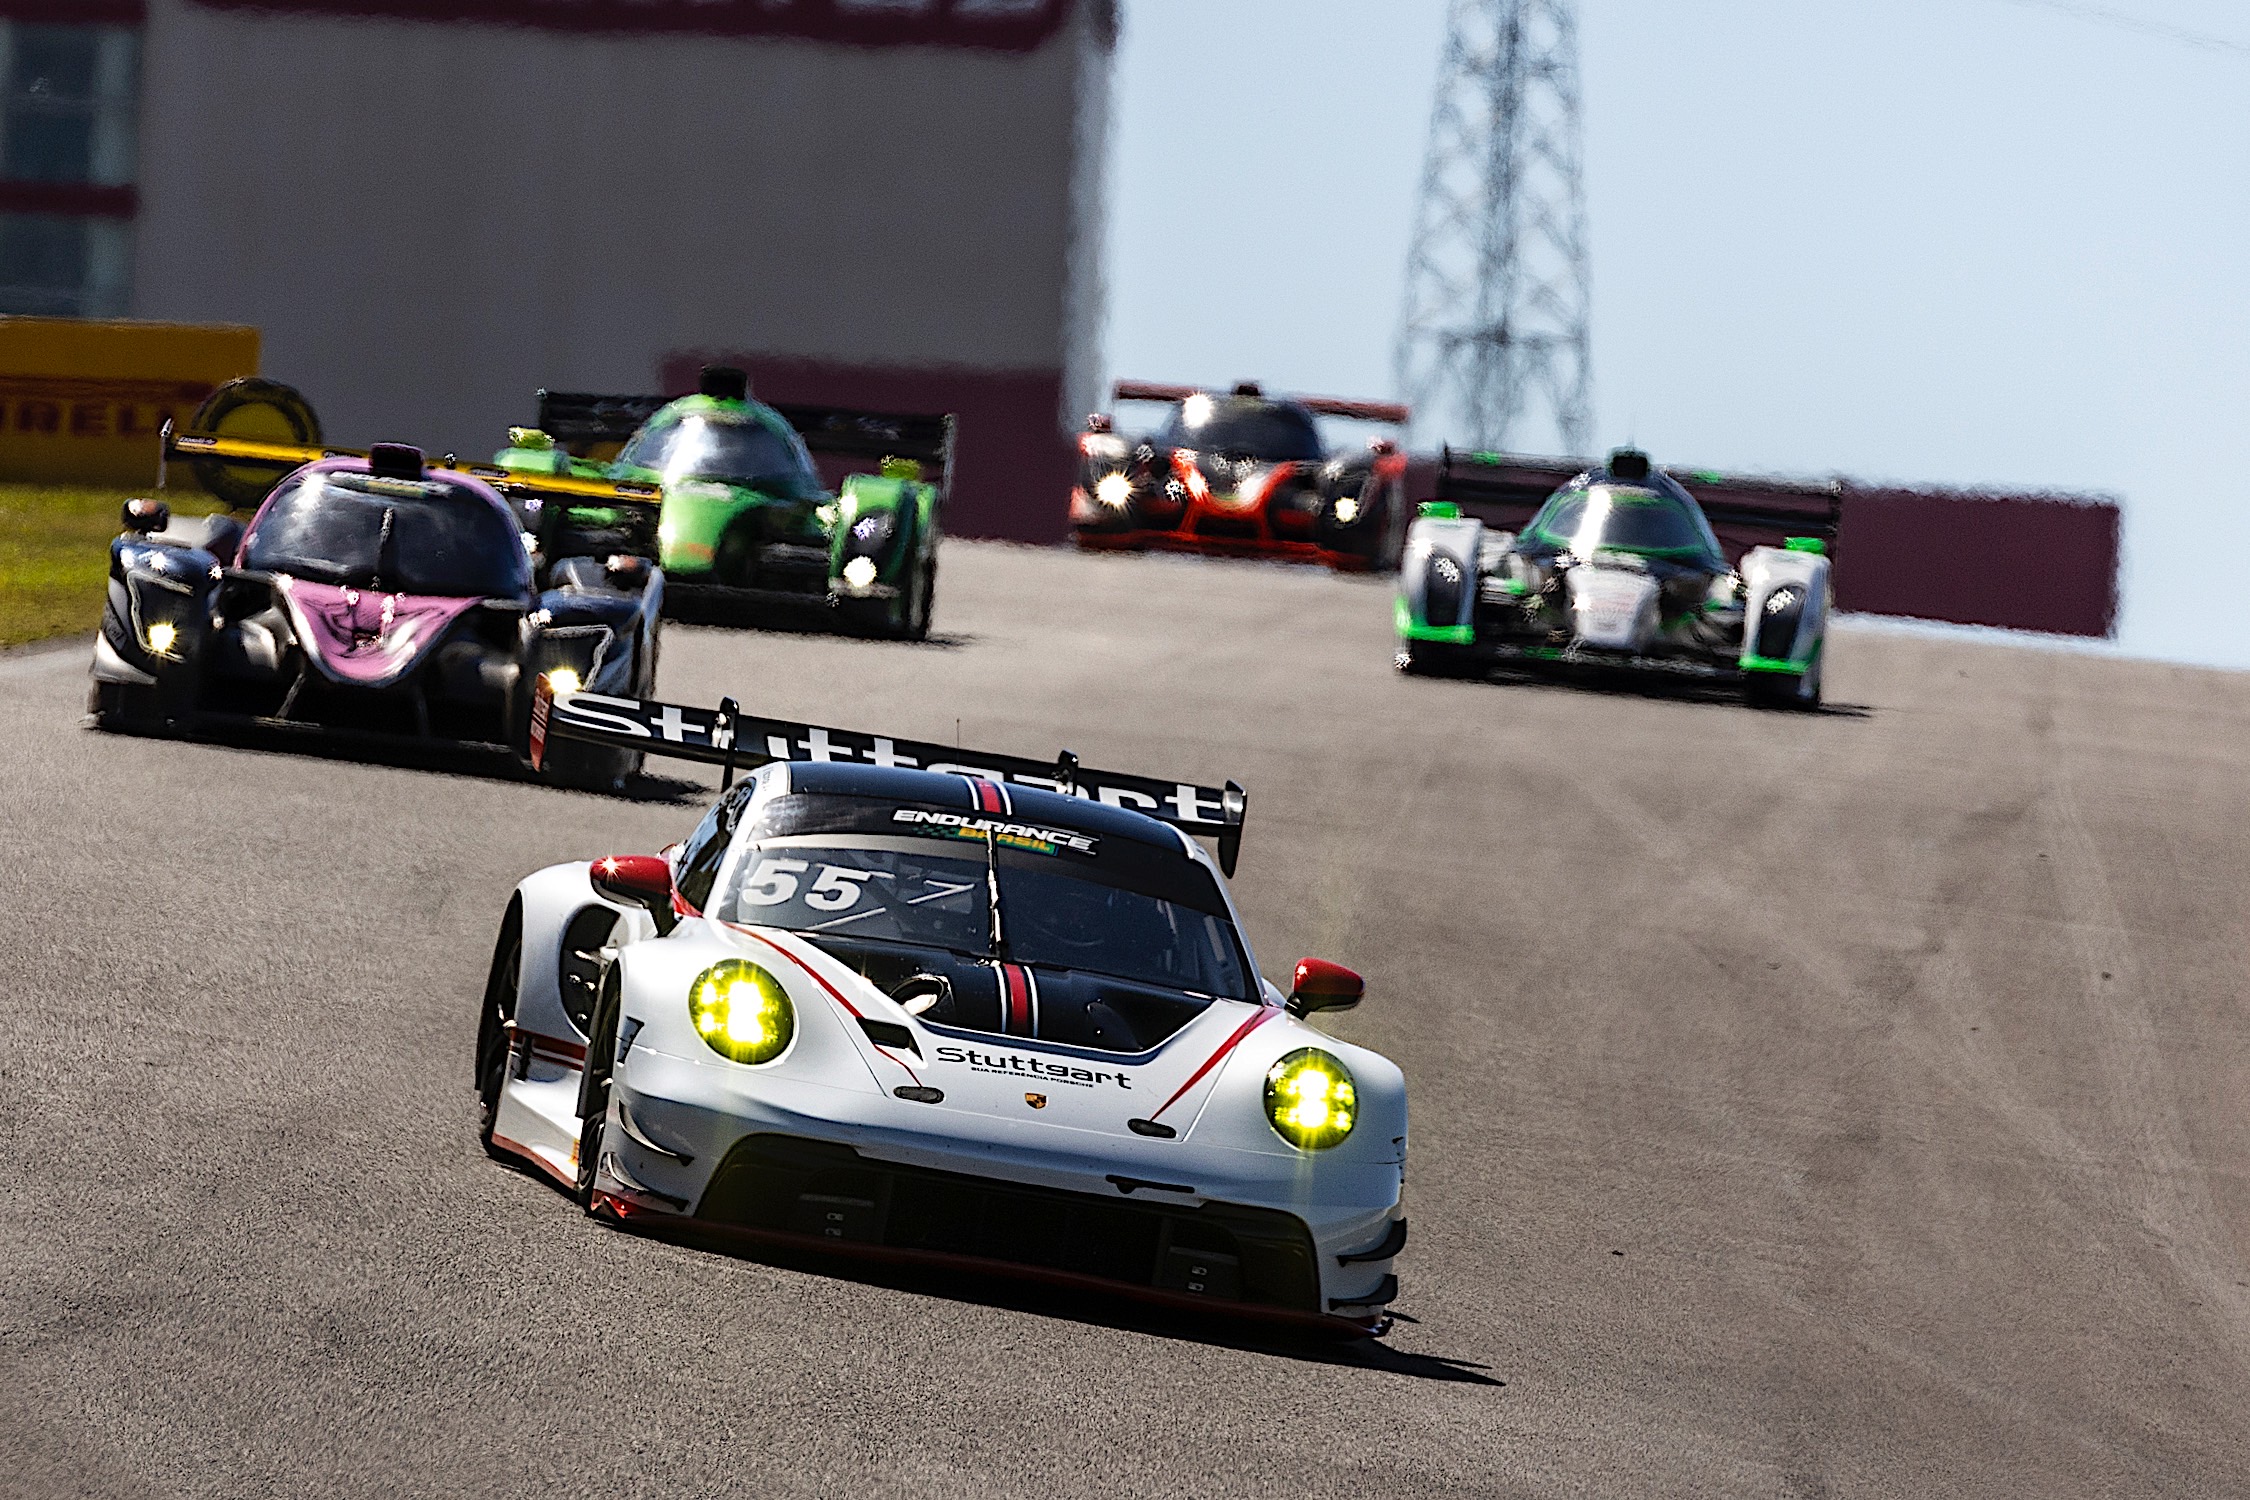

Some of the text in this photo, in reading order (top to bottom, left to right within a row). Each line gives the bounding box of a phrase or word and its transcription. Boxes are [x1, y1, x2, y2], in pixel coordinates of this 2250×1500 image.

[893, 809, 1094, 850] ENDURANCE
[742, 858, 872, 911] 55
[936, 1047, 1132, 1090] Stuttgart
[1050, 1077, 1094, 1088] PORSCHE
